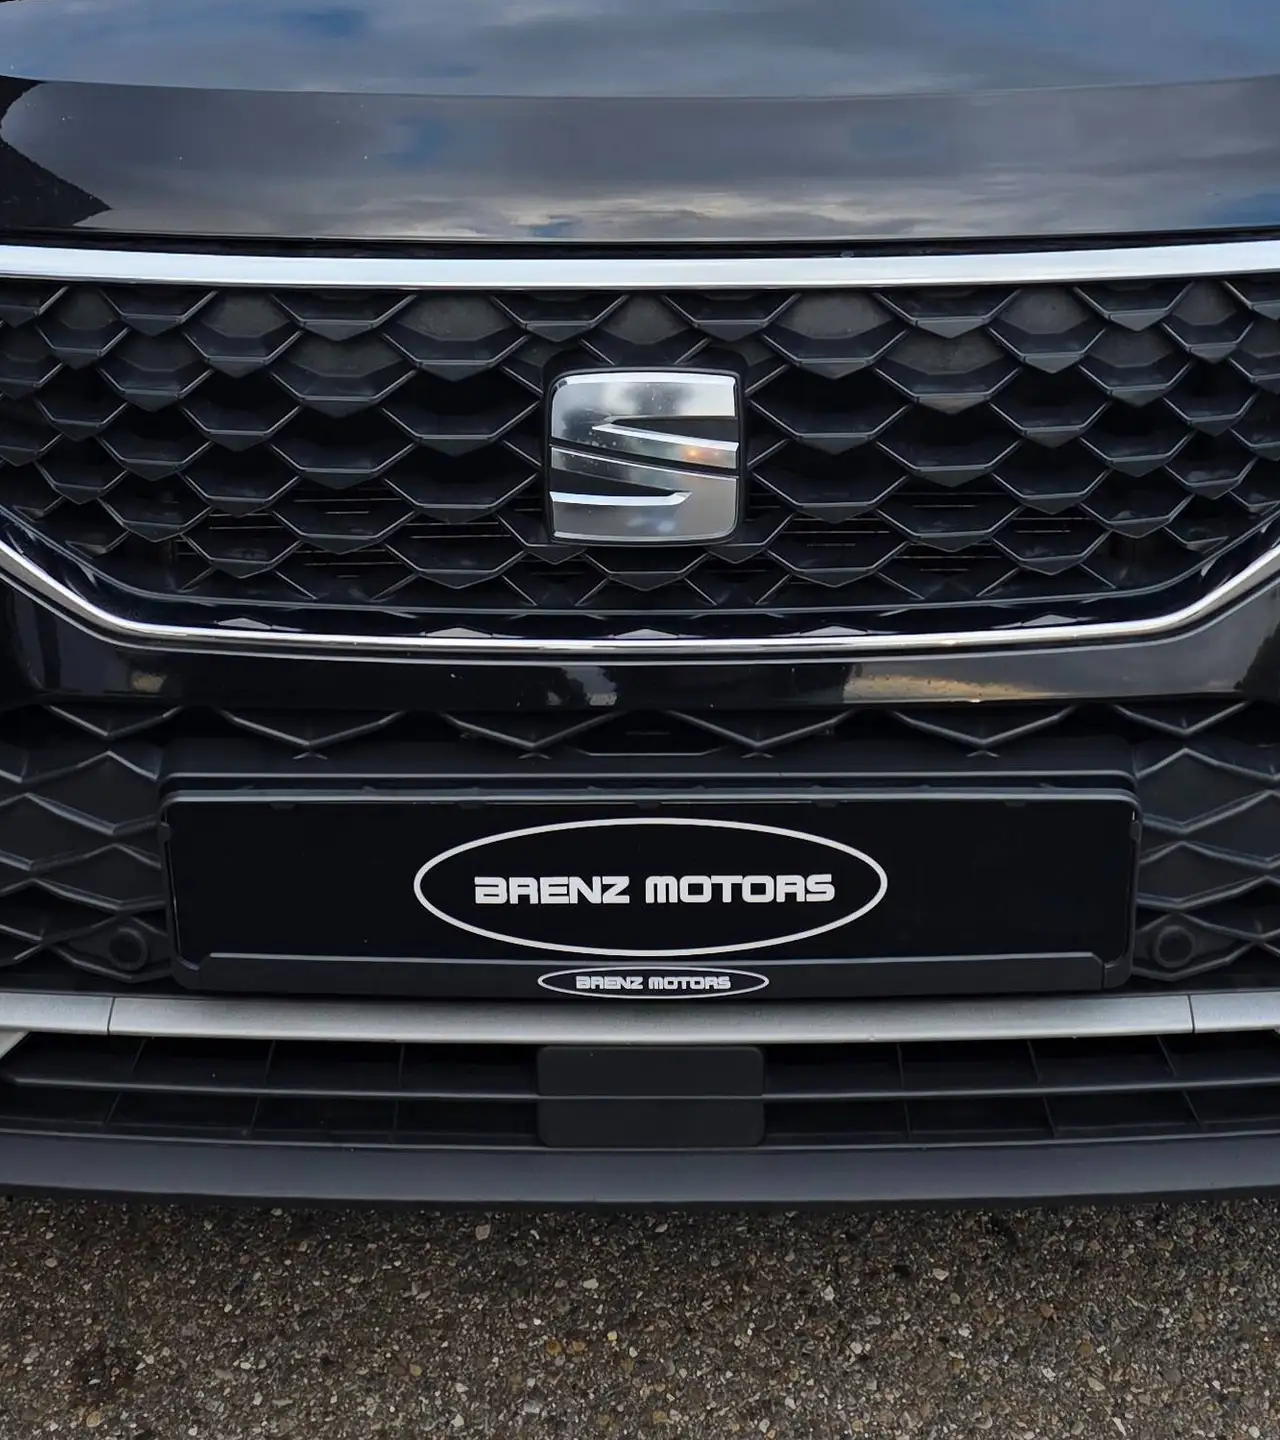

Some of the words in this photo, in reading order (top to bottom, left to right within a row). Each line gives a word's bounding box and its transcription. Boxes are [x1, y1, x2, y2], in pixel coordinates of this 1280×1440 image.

[474, 876, 631, 905] BRENZ
[645, 874, 836, 903] MOTORS
[575, 976, 643, 989] BRENZ
[648, 976, 731, 989] MOTORS
